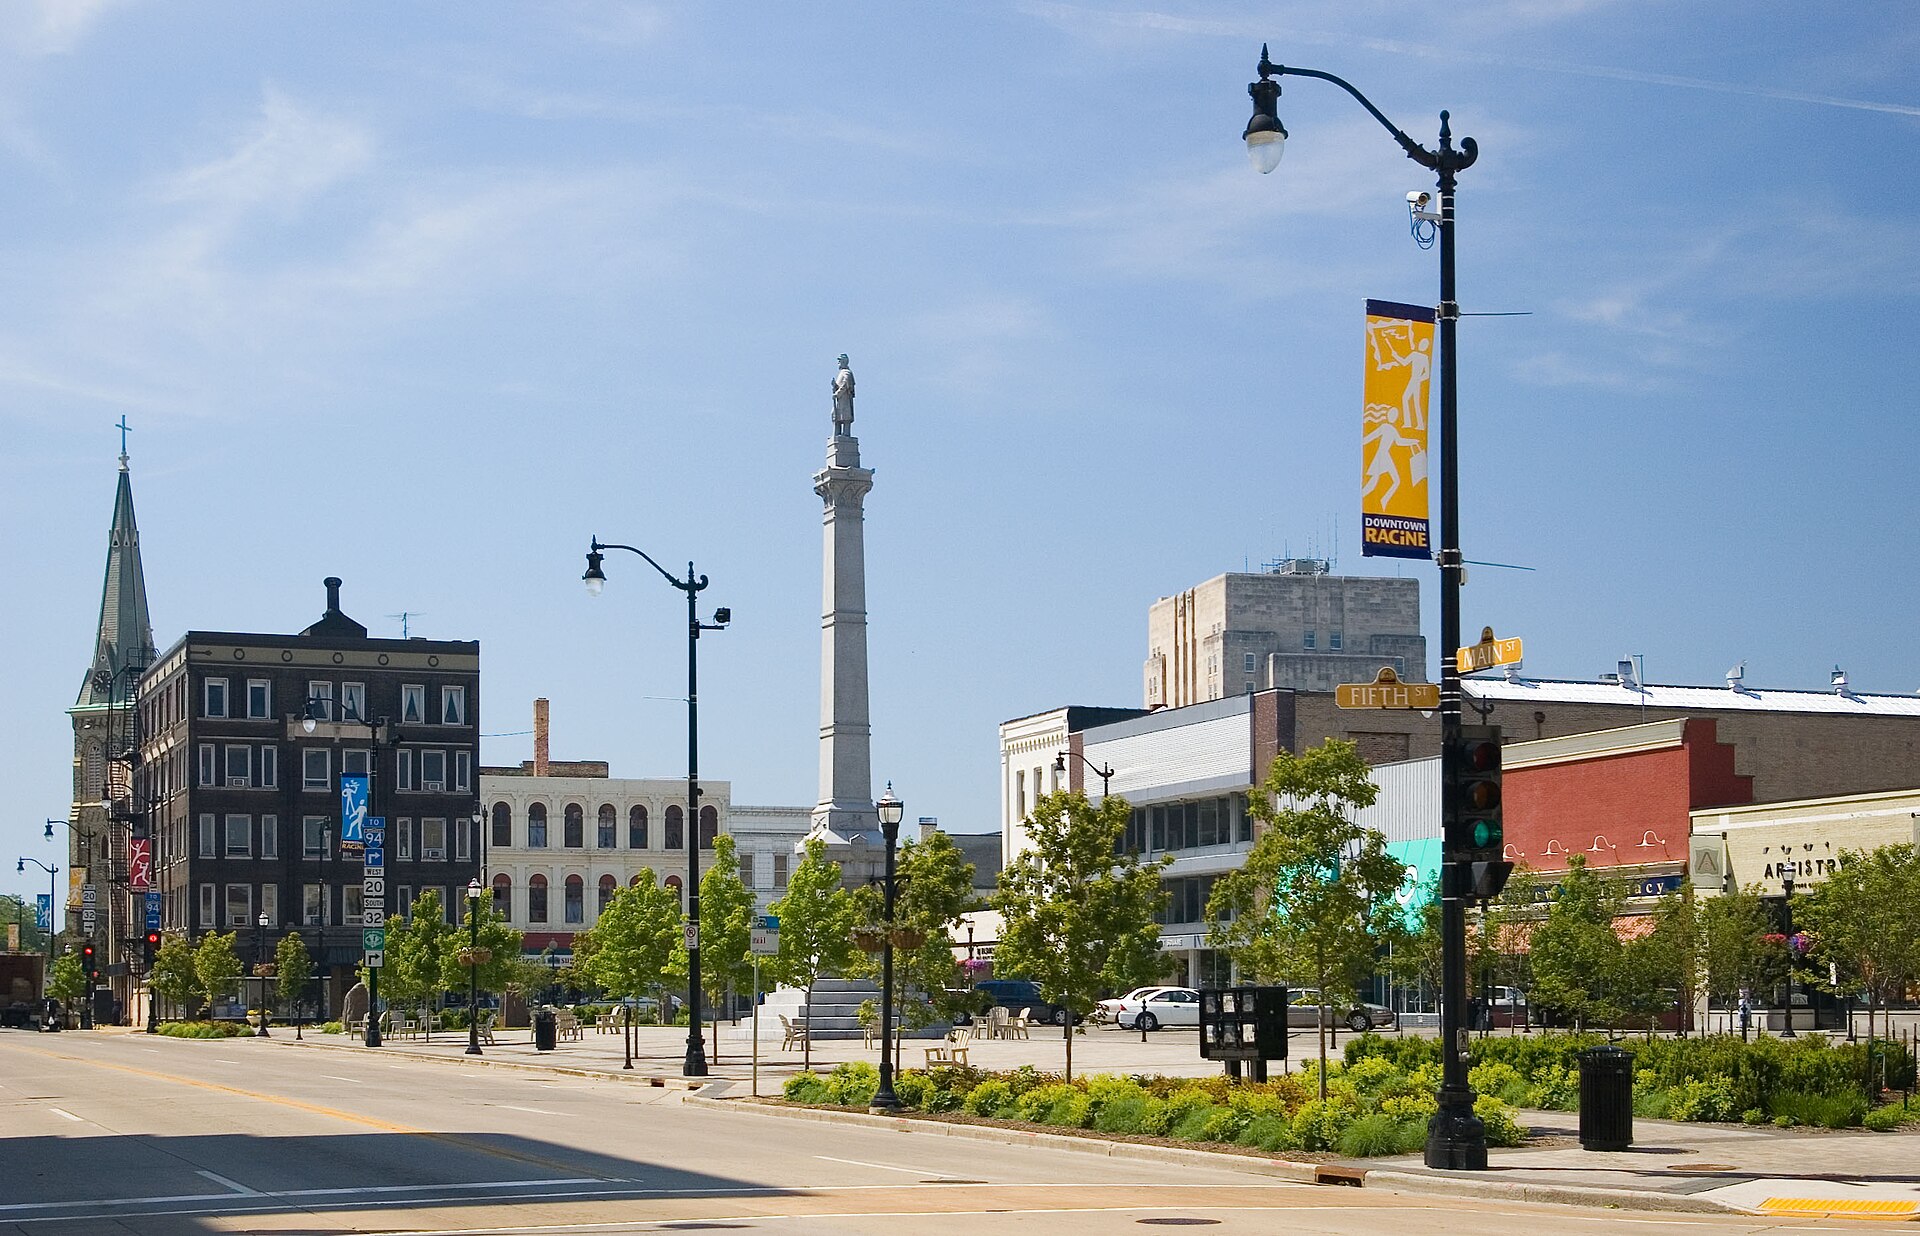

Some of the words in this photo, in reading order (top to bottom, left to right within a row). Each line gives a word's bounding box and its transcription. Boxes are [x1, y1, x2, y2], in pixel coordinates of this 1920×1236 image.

[1365, 517, 1426, 532] DOWNTOWN
[1463, 643, 1503, 669] MAIN
[1506, 642, 1516, 652] ST
[1351, 687, 1409, 706] FIFTH
[1415, 686, 1428, 697] ST
[366, 832, 382, 844] 94
[365, 881, 383, 893] 20
[84, 892, 95, 901] 20
[146, 903, 160, 912] 94
[365, 899, 384, 907] SOUTH
[84, 911, 95, 919] 32
[366, 912, 382, 924] 32
